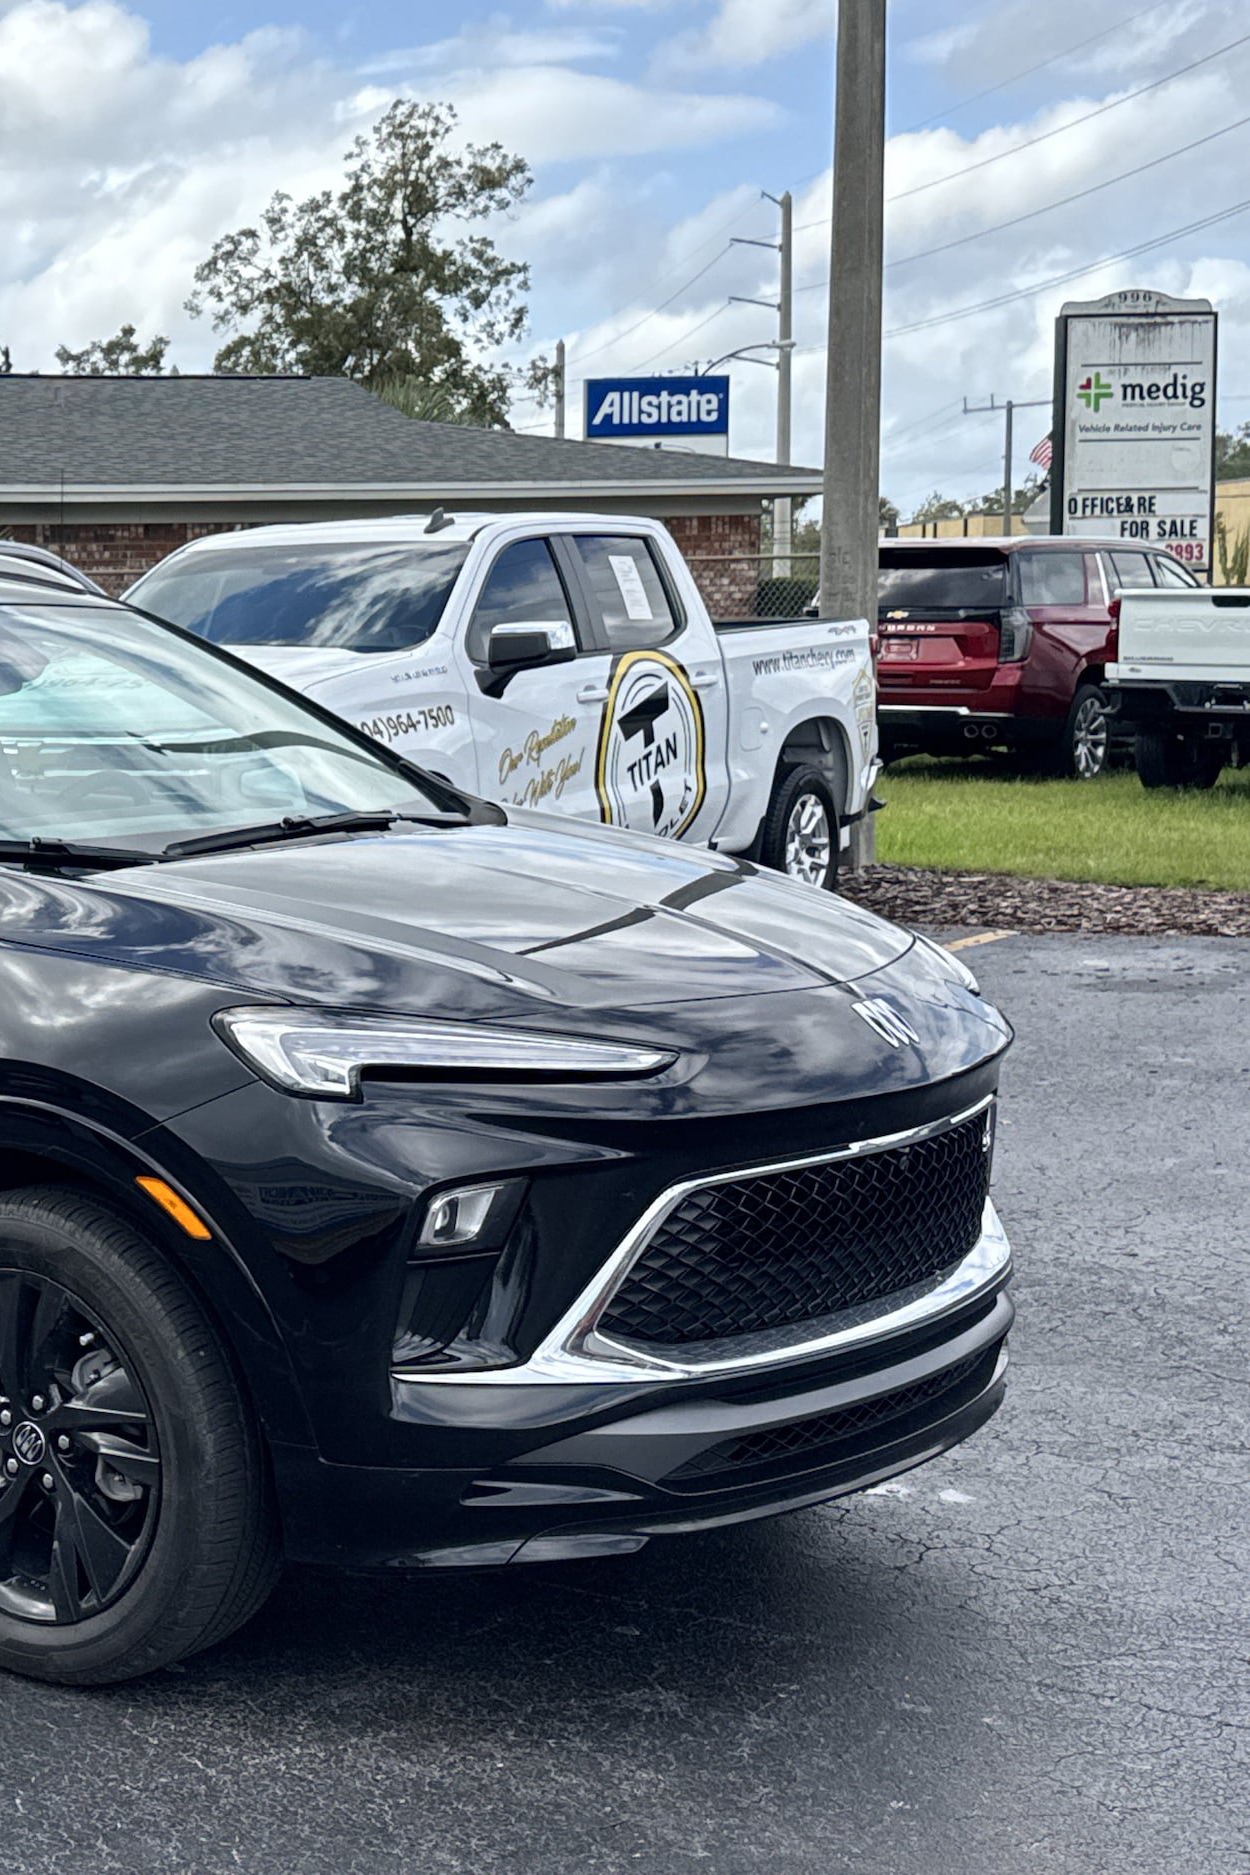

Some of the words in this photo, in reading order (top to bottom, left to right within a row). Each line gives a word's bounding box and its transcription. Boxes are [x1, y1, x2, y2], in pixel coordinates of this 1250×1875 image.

[591, 389, 718, 425] Allstate
[1121, 373, 1206, 408] medig
[1078, 423, 1111, 433] Vehicle
[1113, 421, 1150, 432] Related
[1152, 422, 1178, 433] Injury
[1180, 421, 1202, 431] Care
[1120, 520, 1150, 538] FOR
[1157, 519, 1198, 537] SALE
[627, 732, 677, 792] TITAN
